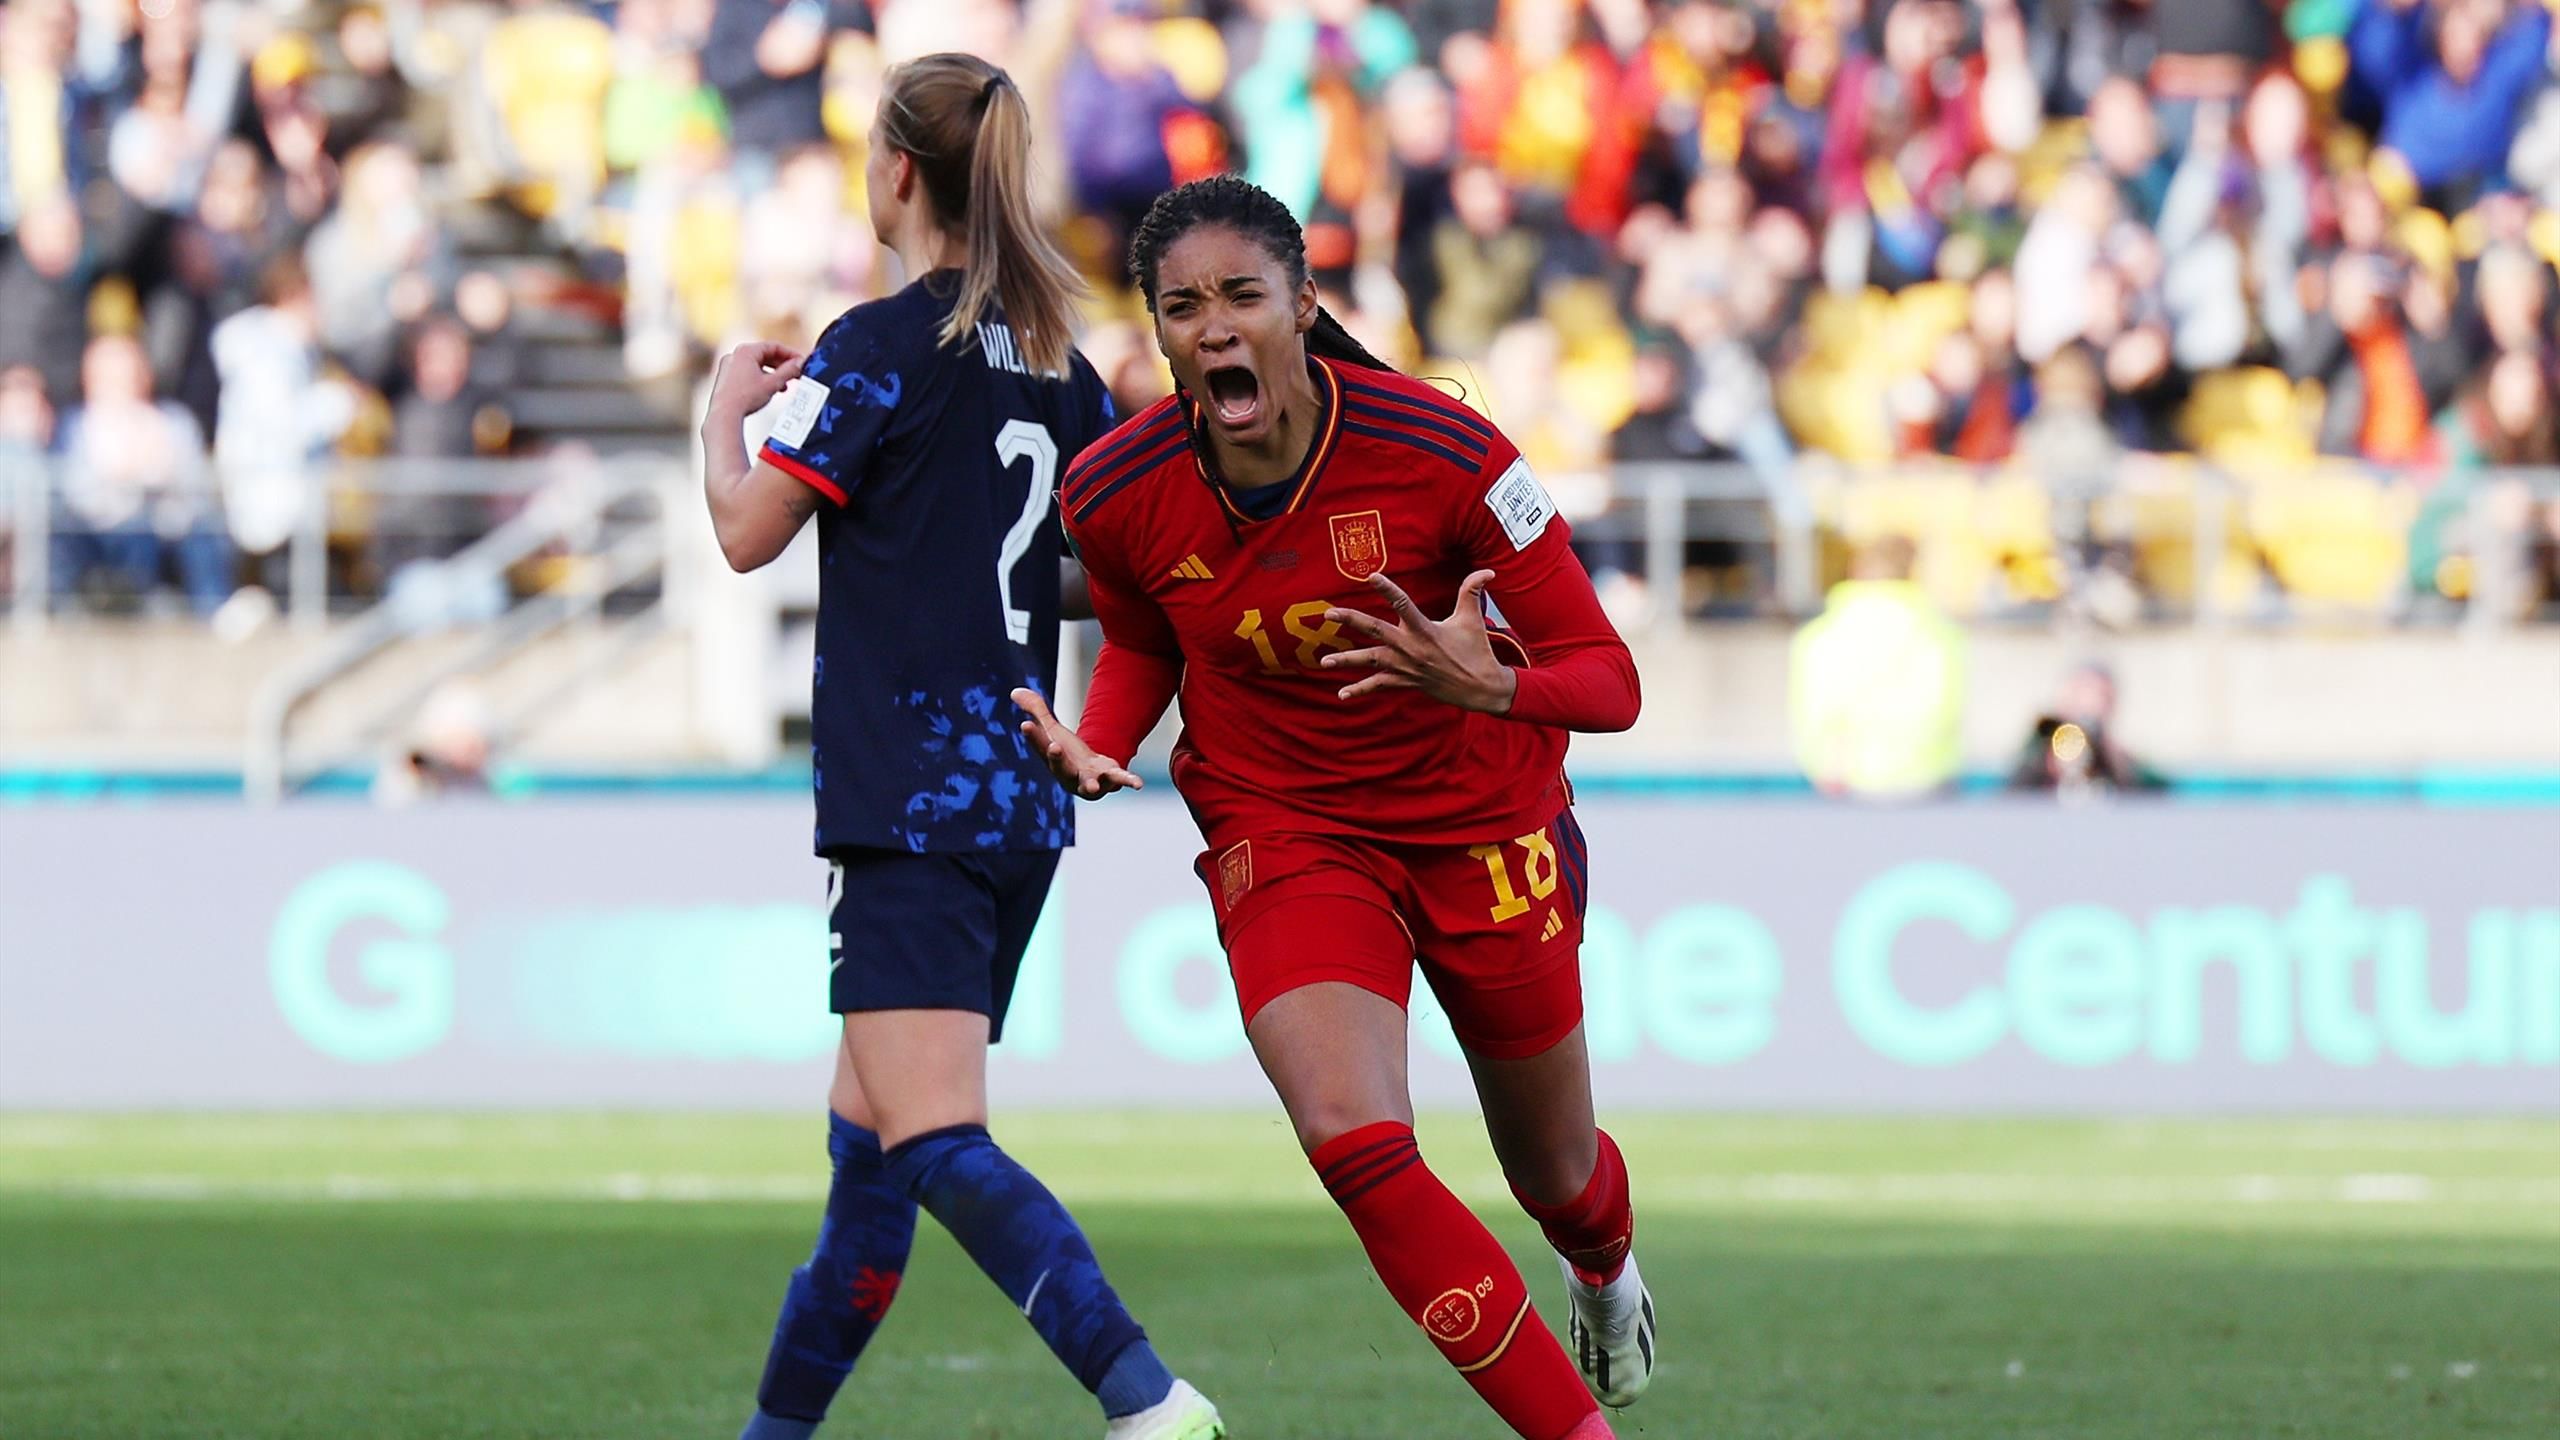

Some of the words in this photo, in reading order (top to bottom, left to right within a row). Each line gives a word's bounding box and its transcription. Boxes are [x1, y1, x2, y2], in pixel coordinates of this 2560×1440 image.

[976, 320, 1059, 379] WIL
[1506, 480, 1533, 512] UNITES
[995, 418, 1059, 646] 2
[1234, 600, 1354, 676] 18
[1467, 826, 1557, 923] 18
[1475, 1275, 1494, 1299] 09
